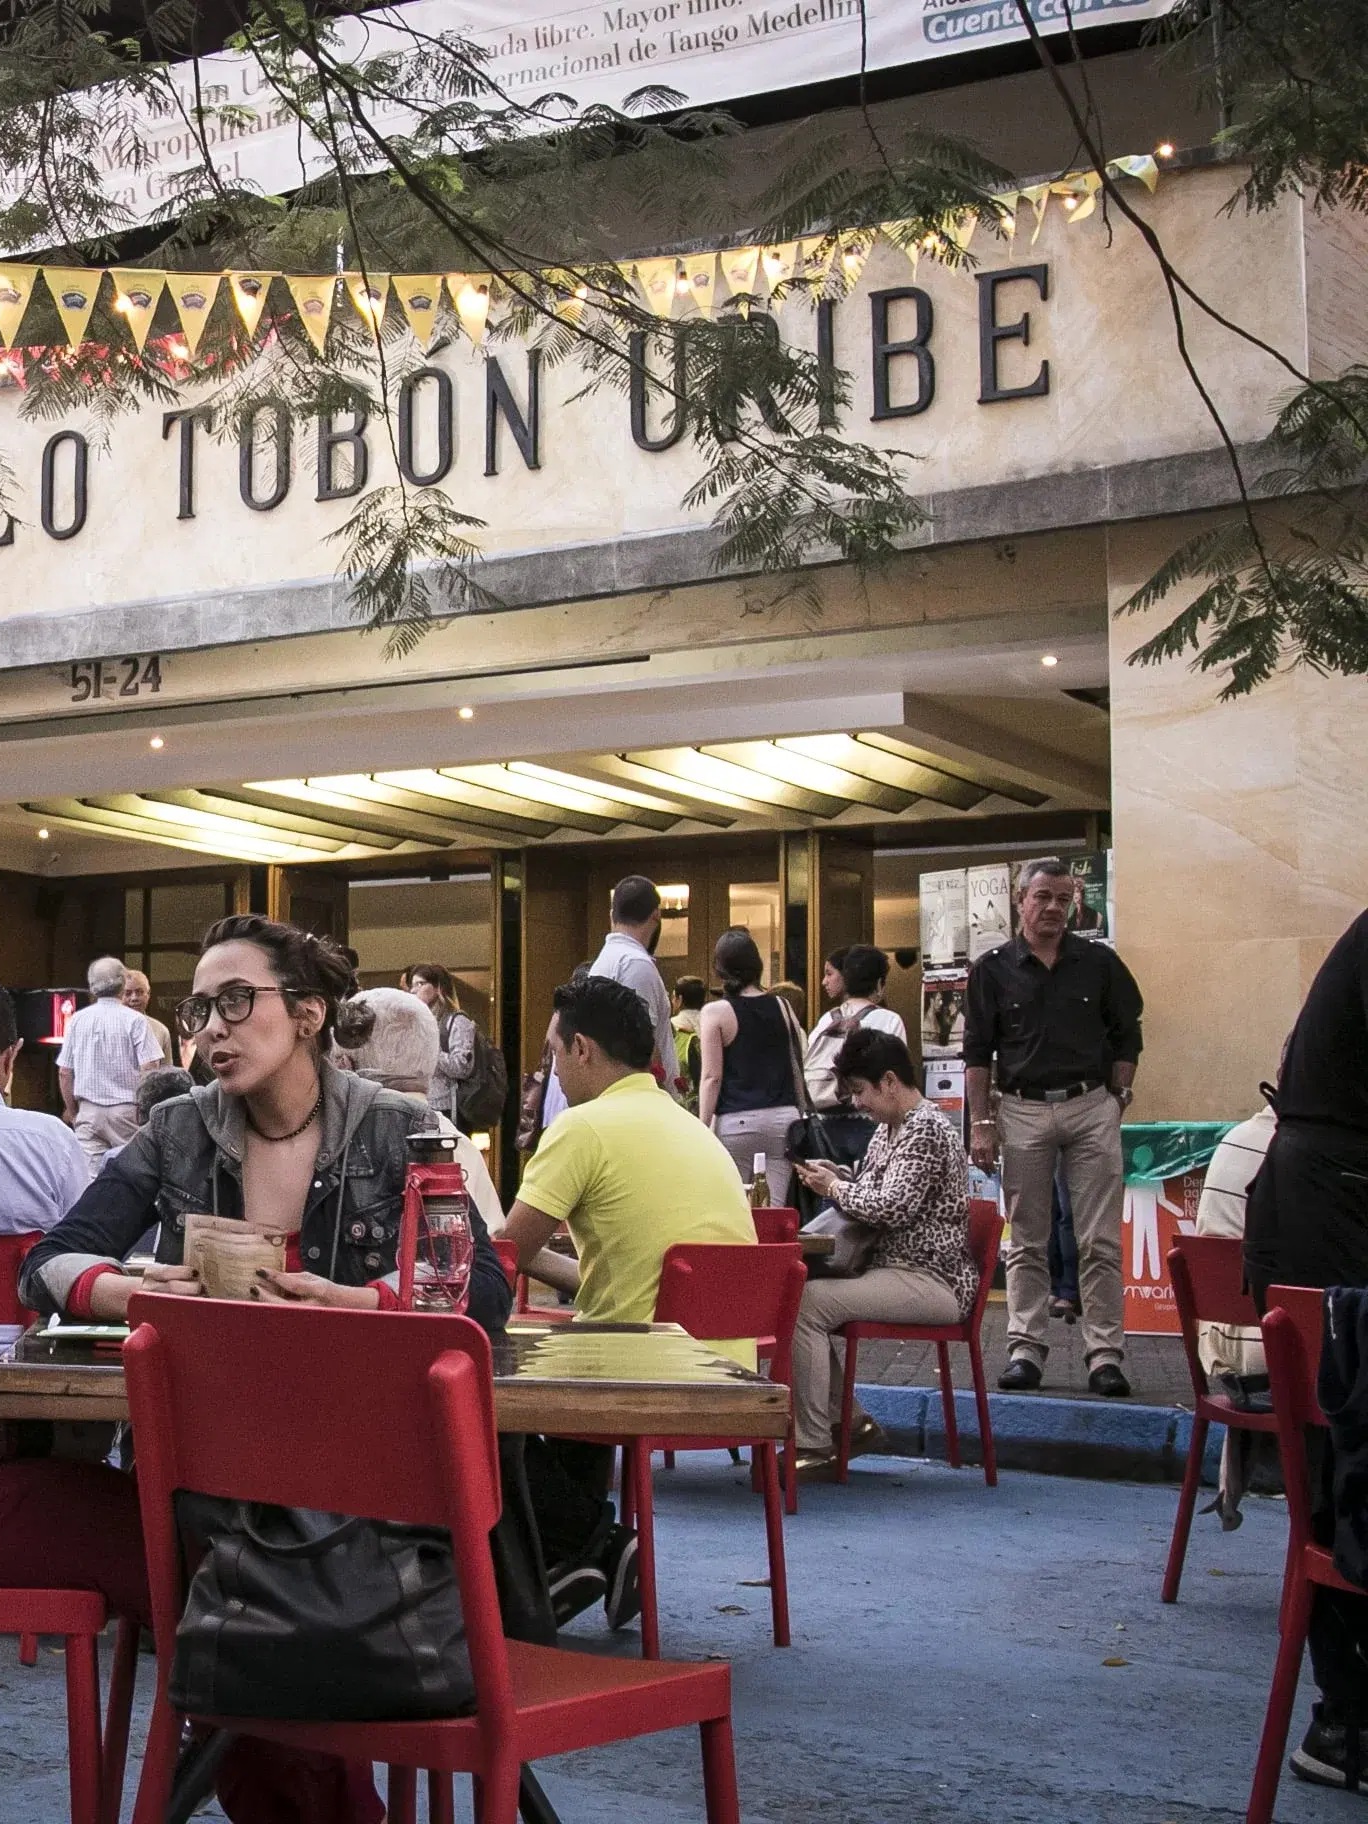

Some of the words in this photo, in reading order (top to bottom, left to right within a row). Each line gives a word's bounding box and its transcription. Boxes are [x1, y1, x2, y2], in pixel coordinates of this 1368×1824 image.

[533, 24, 594, 50] libre.
[602, 6, 680, 34] Mayor
[628, 37, 658, 63] de
[662, 24, 739, 54] Tango
[162, 338, 542, 520] TOBÓN
[71, 655, 162, 702] 51-24
[971, 877, 1009, 898] YOGA
